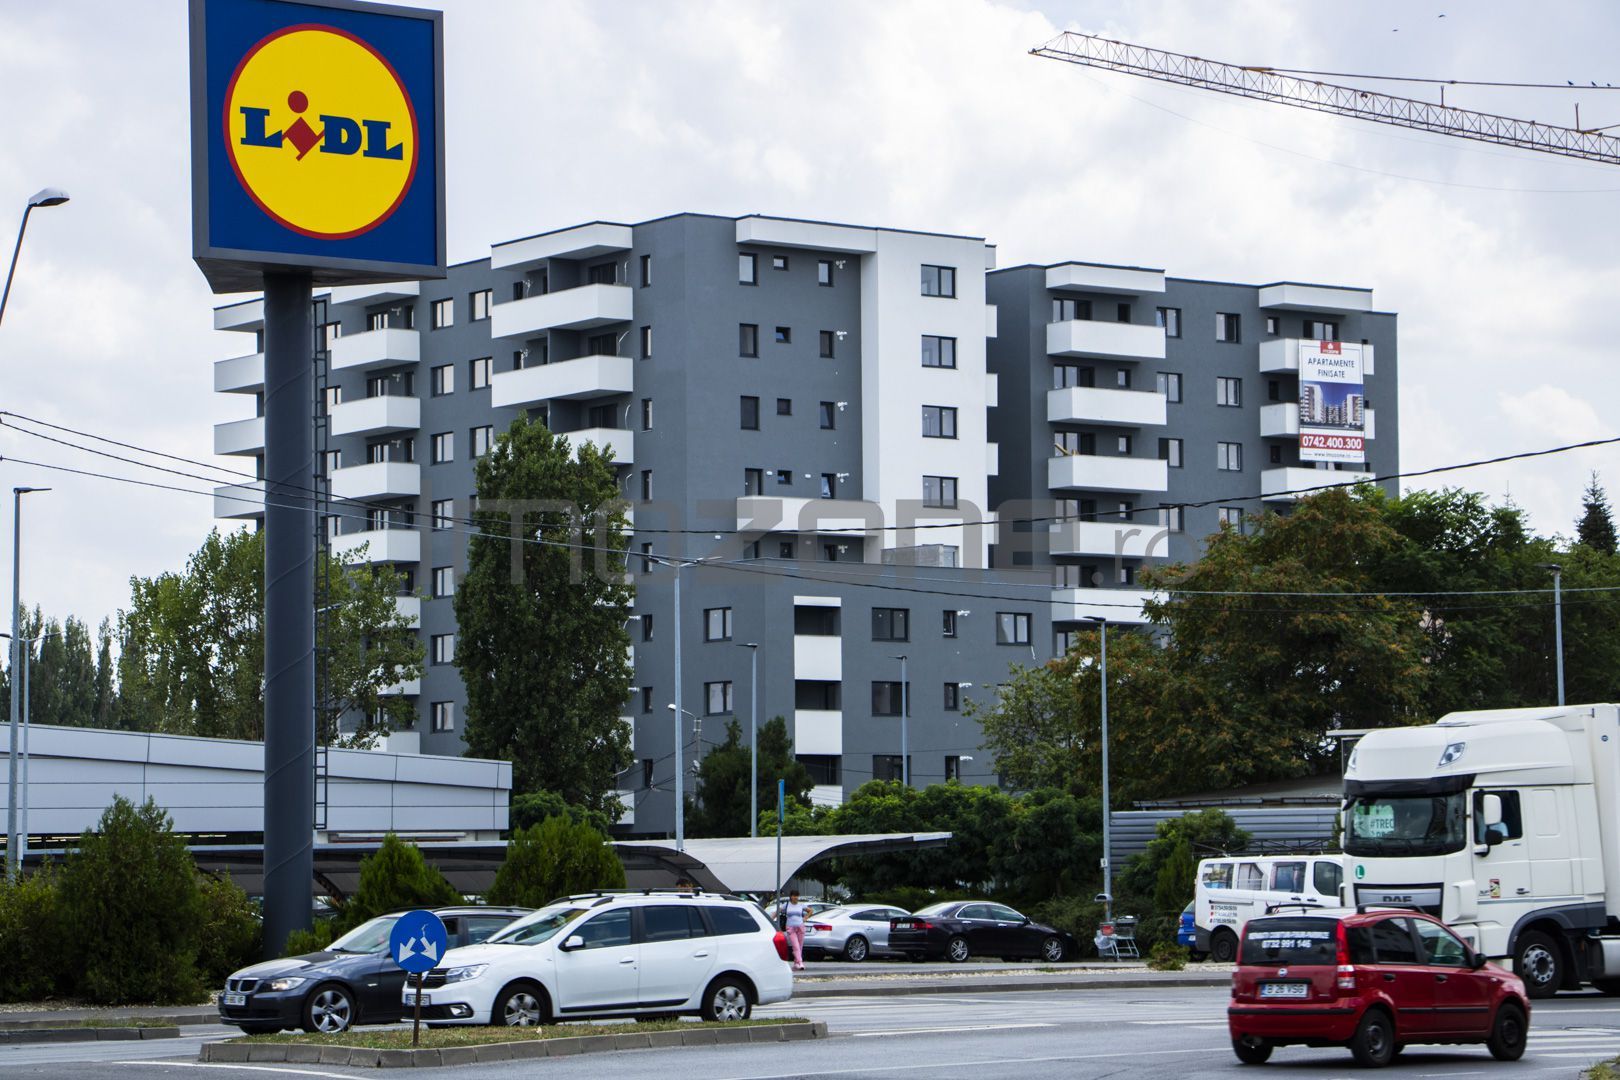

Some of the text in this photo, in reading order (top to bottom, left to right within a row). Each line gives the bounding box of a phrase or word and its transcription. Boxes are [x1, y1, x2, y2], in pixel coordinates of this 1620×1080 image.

[1308, 357, 1355, 368] APARTAMENTE
[1318, 369, 1345, 378] FINISATE
[1303, 435, 1362, 449] 0742.400.300
